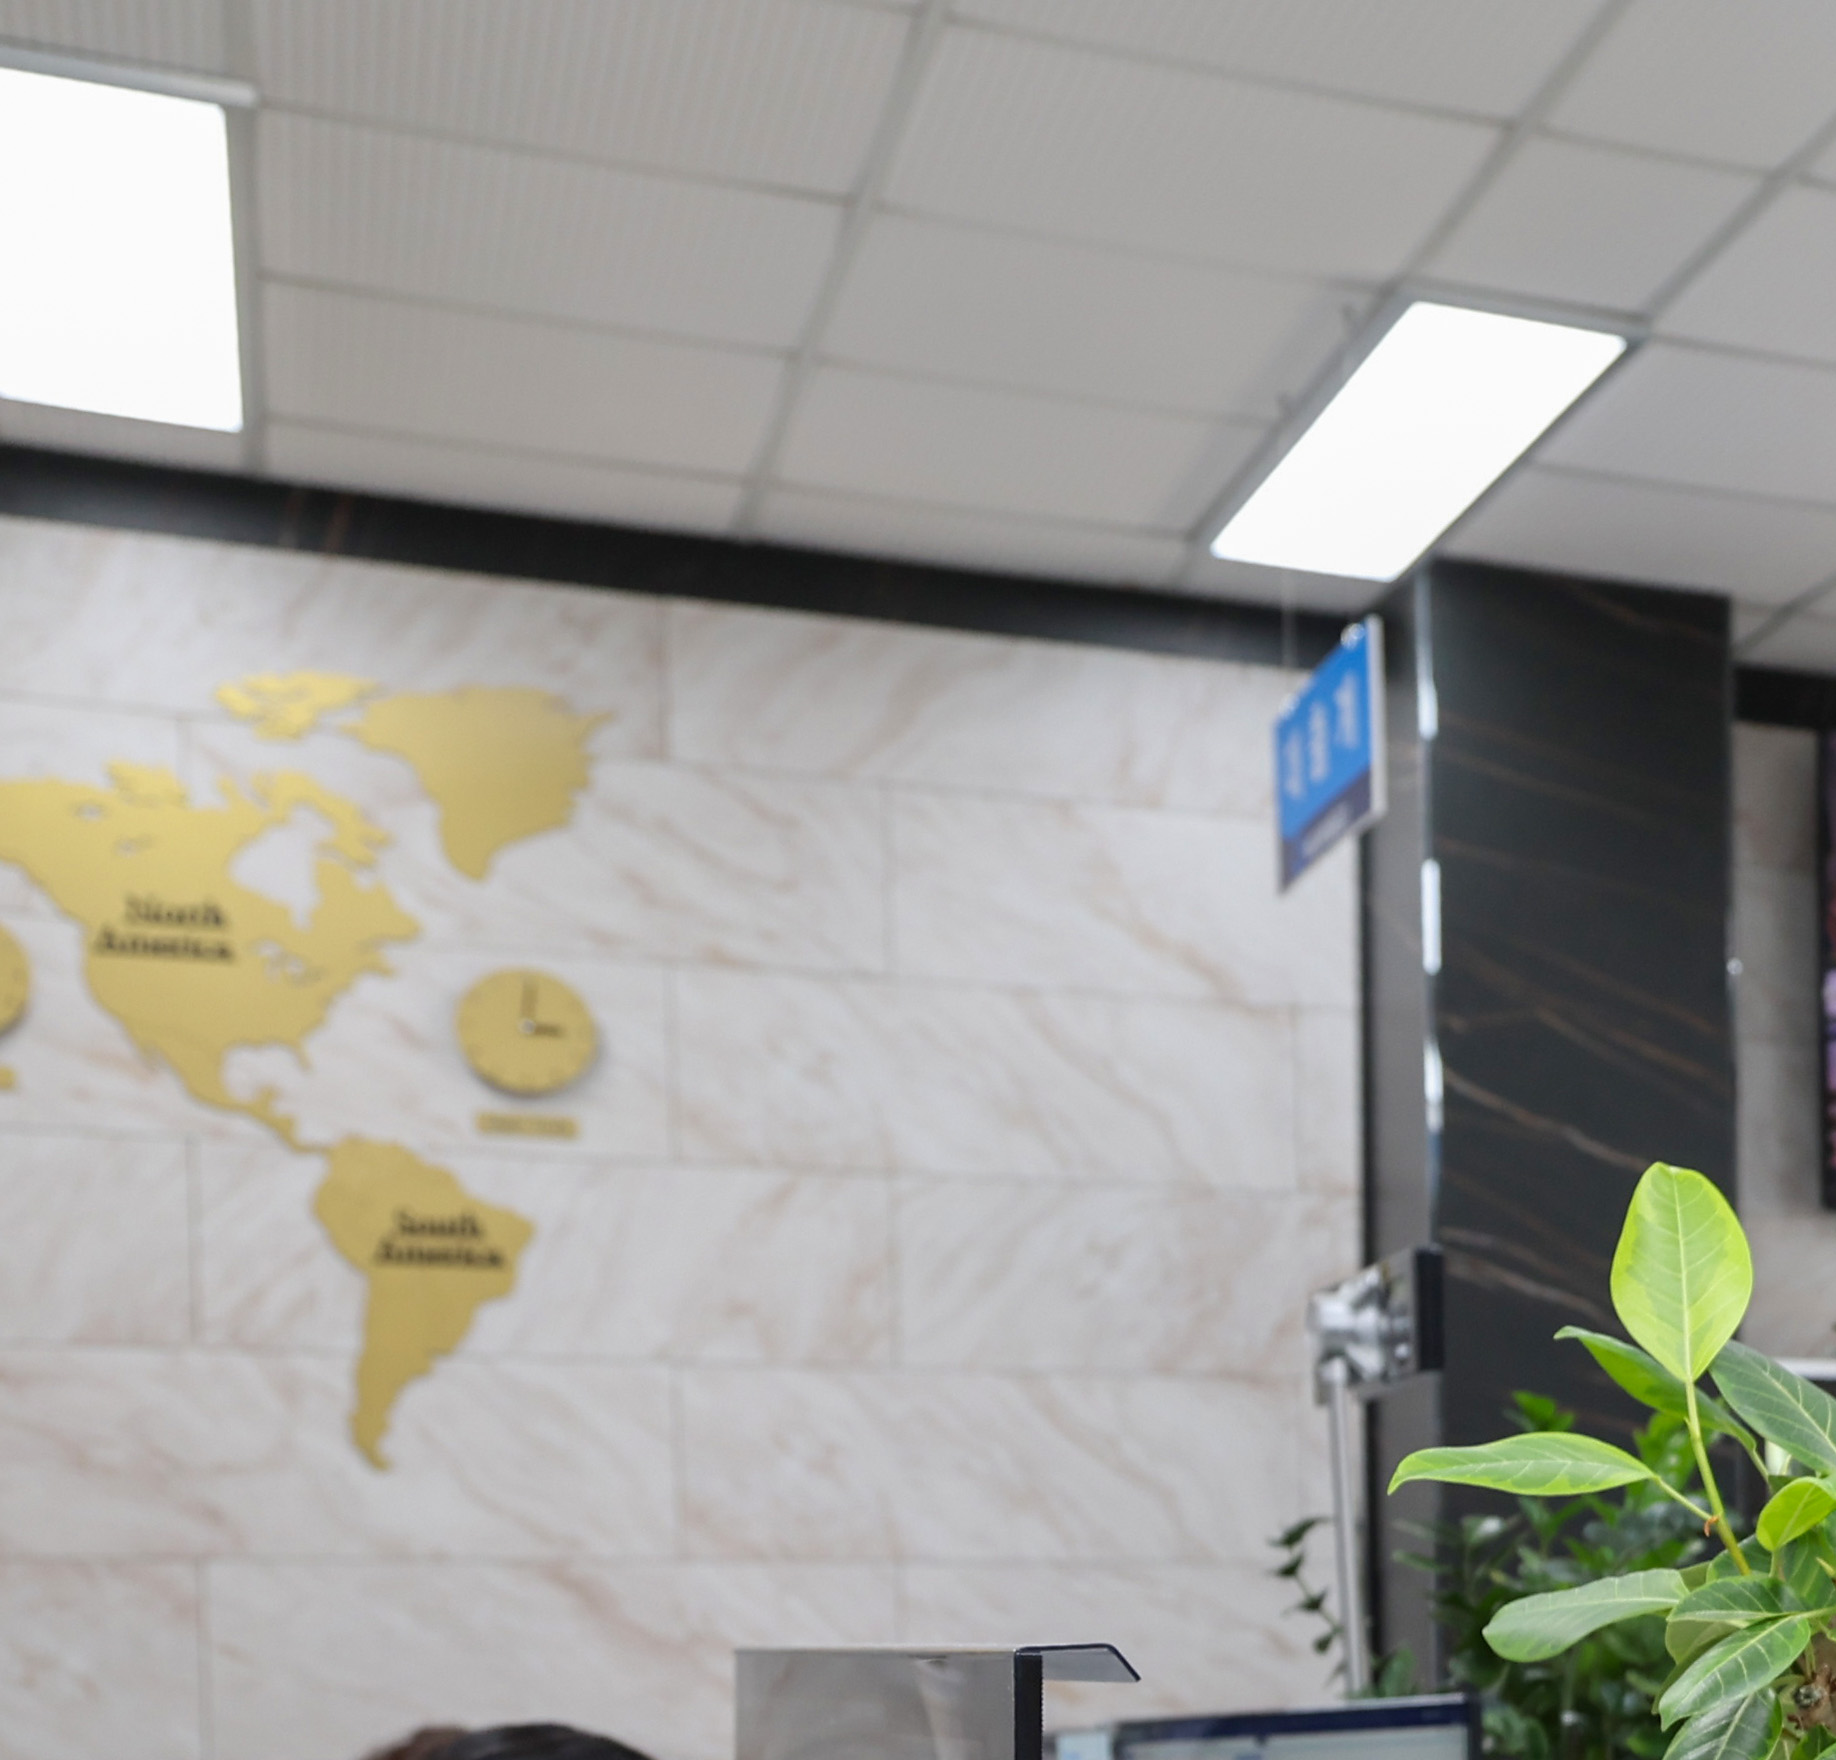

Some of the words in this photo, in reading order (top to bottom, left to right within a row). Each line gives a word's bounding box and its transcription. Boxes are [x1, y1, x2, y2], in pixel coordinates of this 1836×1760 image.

[125, 893, 227, 927] North
[94, 925, 236, 962] America
[397, 1206, 482, 1238] South
[376, 1238, 507, 1270] America
